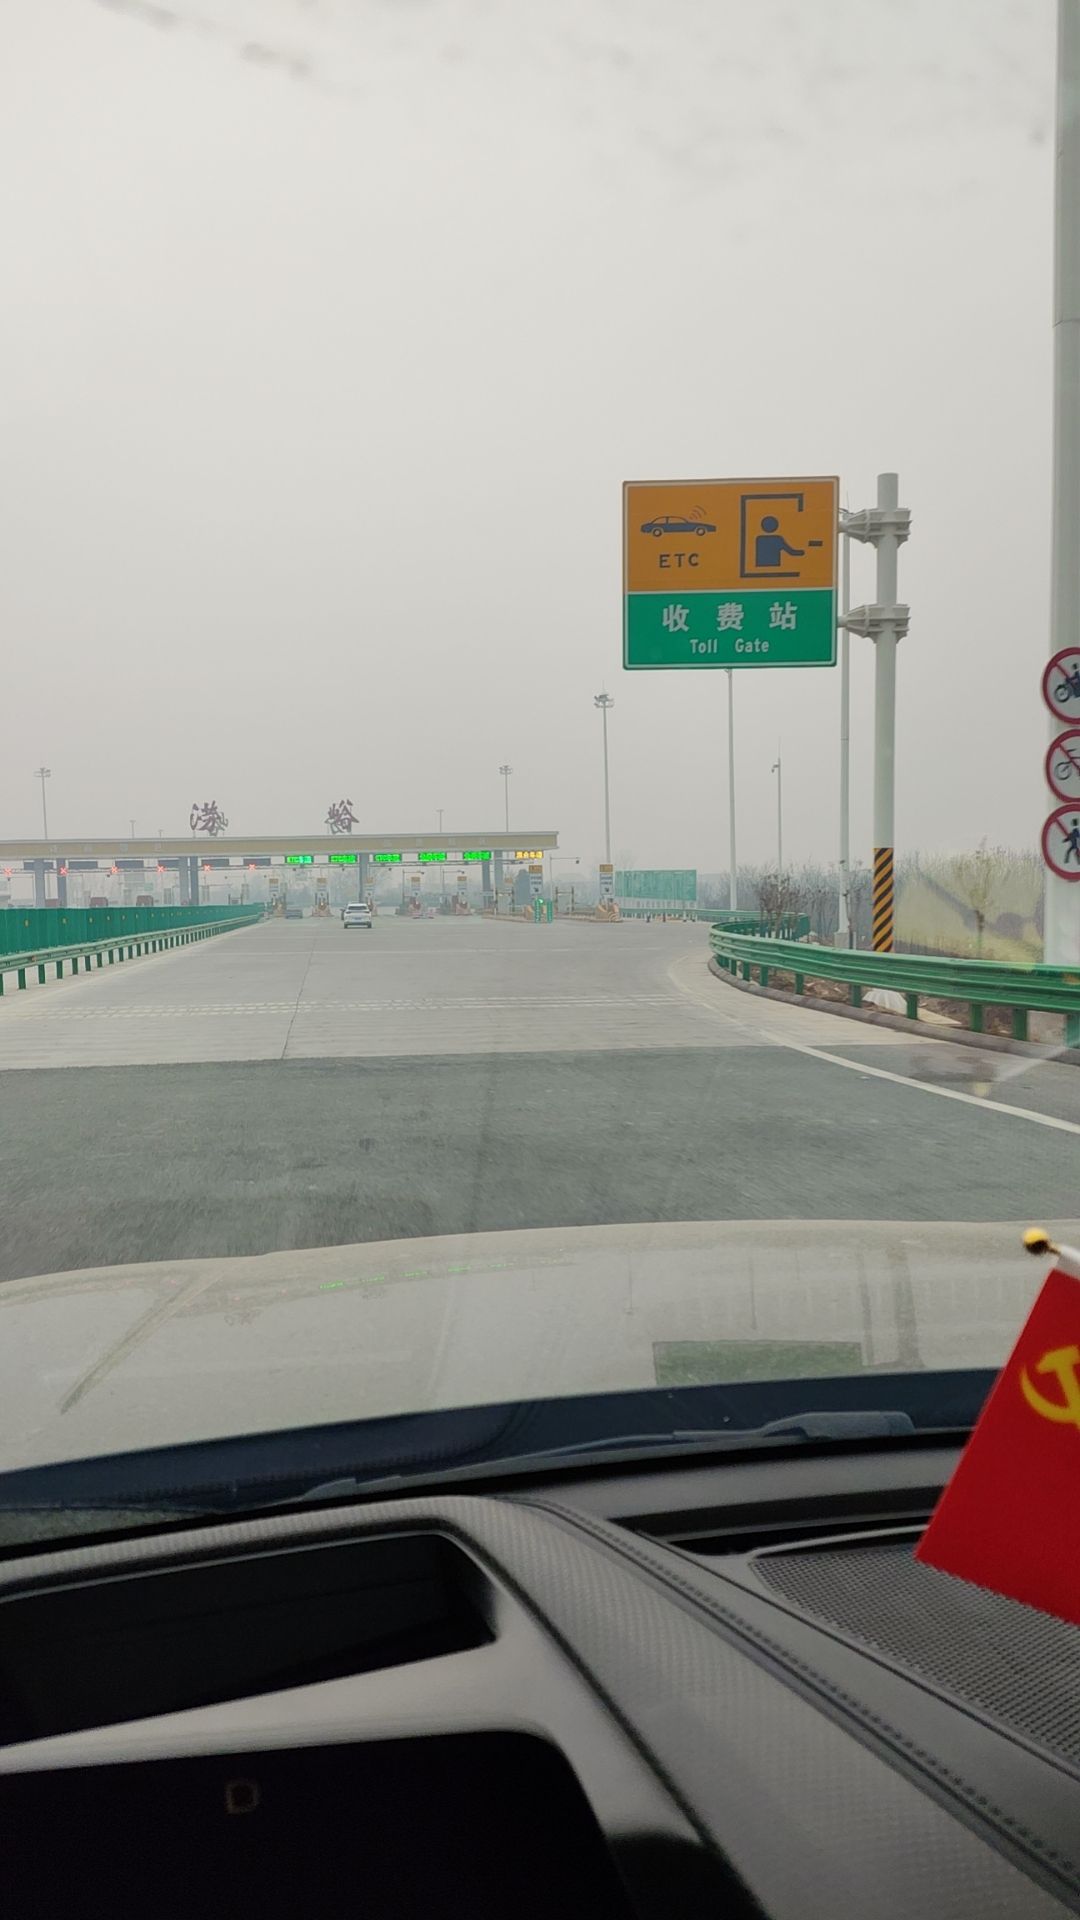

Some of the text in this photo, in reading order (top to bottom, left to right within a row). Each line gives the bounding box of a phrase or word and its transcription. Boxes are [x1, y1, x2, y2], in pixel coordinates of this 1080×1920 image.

[659, 553, 699, 568] ETC
[662, 601, 798, 632] 收费站
[690, 638, 770, 654] Toll Gate
